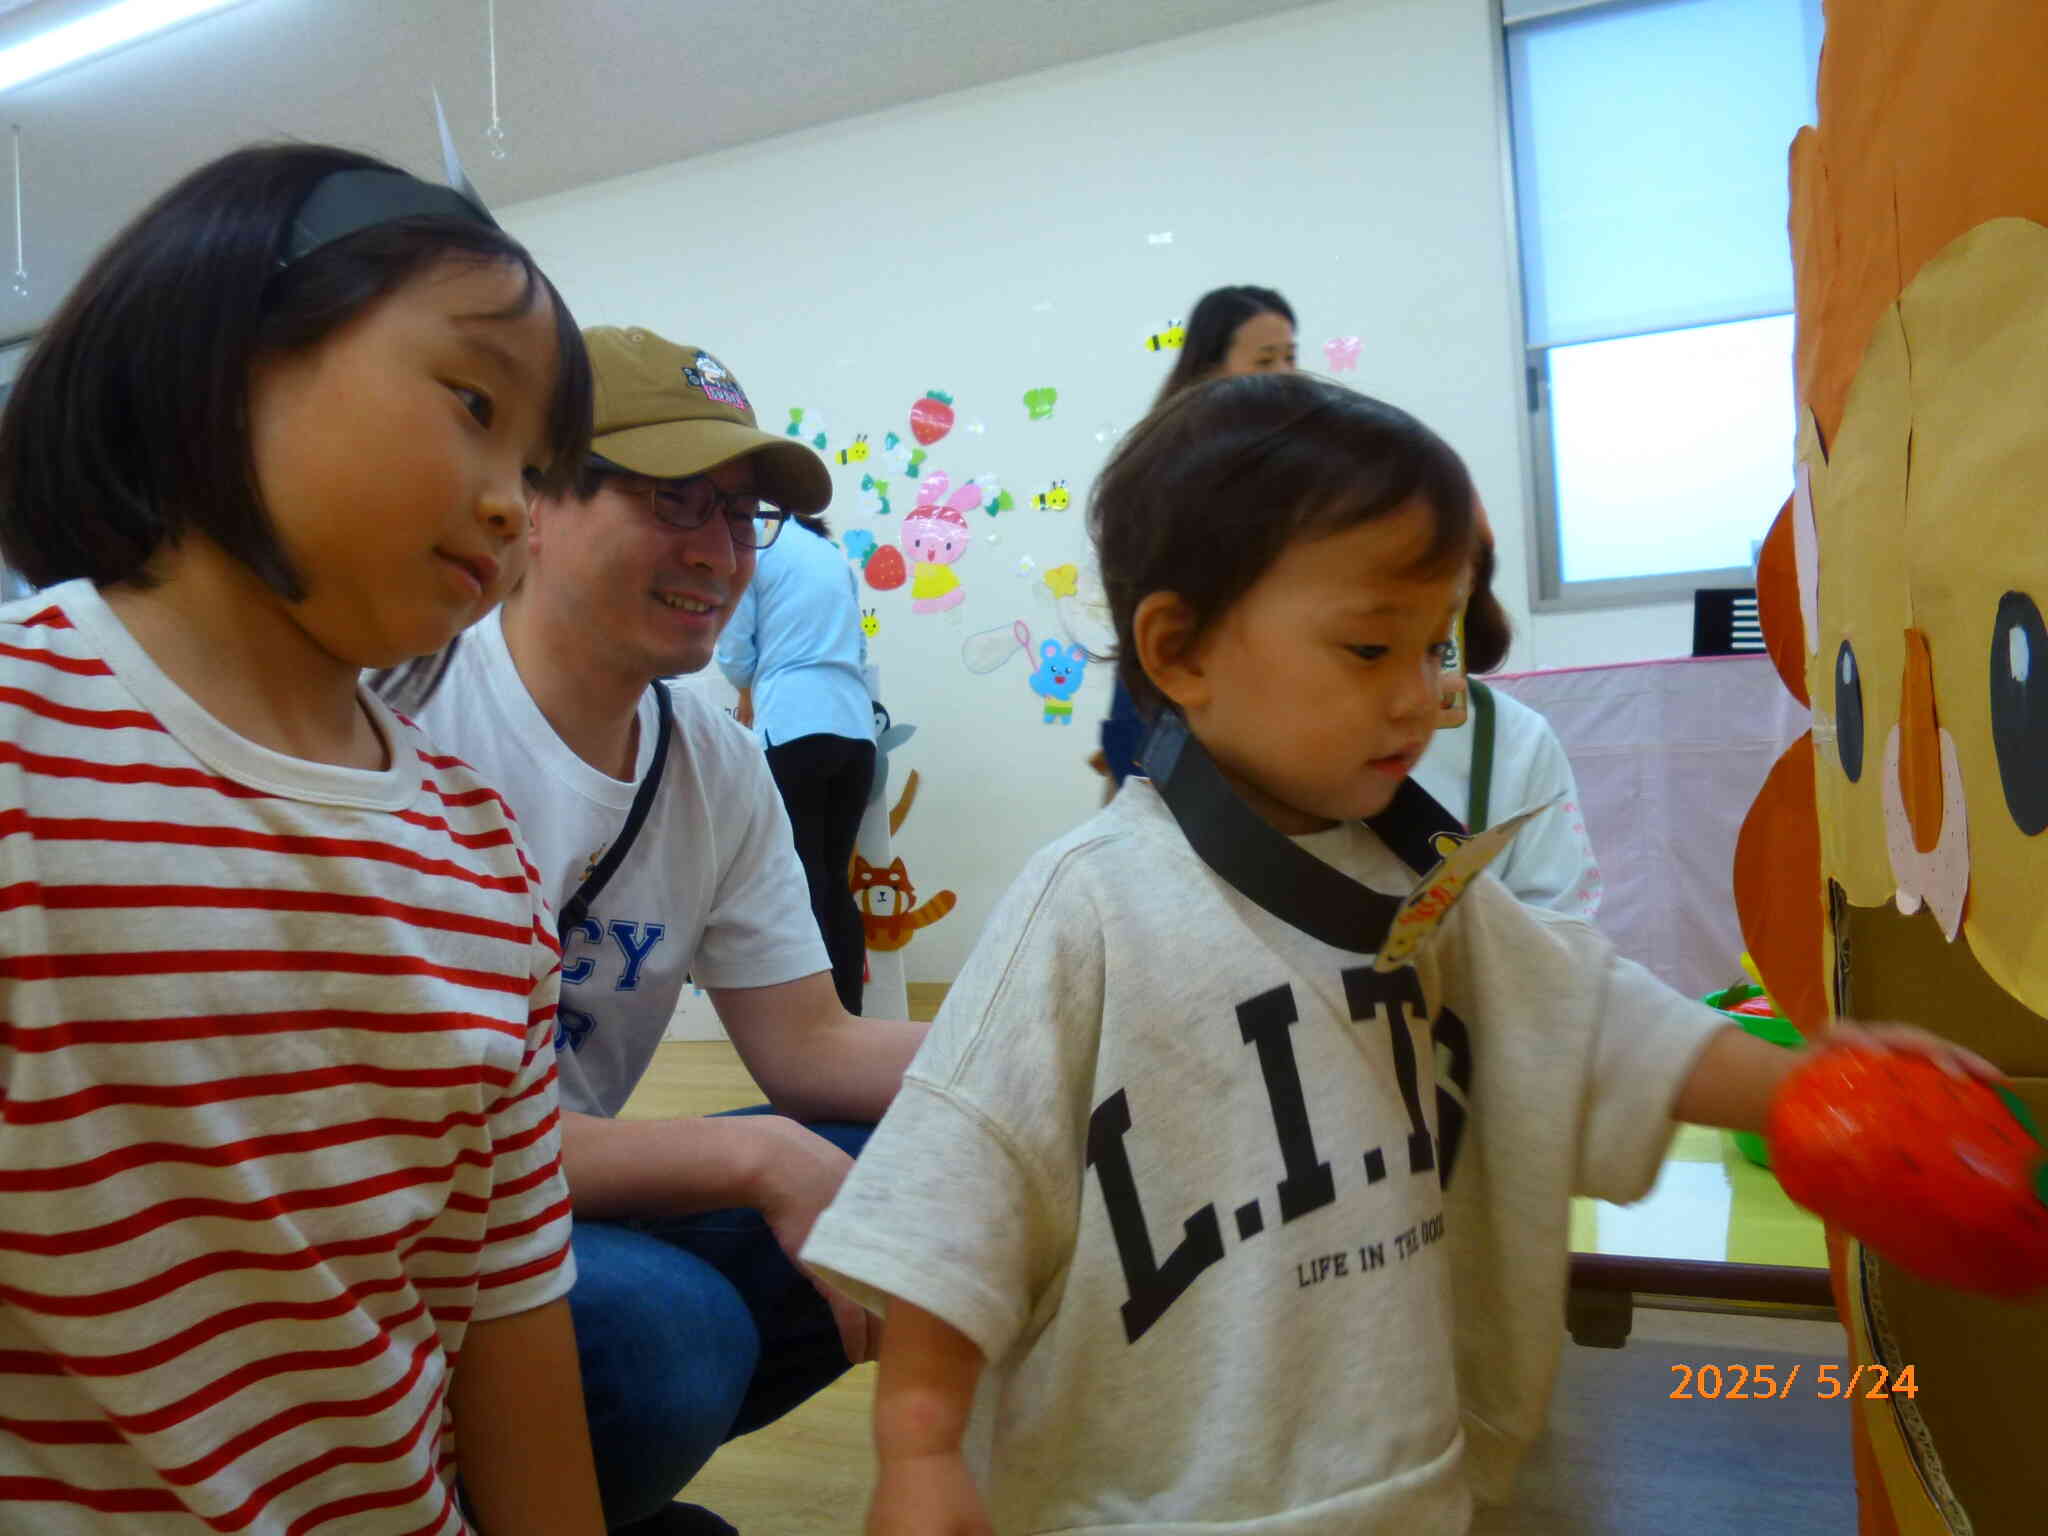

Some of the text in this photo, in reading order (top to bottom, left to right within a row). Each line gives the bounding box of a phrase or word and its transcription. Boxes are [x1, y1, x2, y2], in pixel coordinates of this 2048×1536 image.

[1297, 1252, 1349, 1289] LIFE
[1359, 1242, 1386, 1272] IN
[1394, 1226, 1420, 1261] THE
